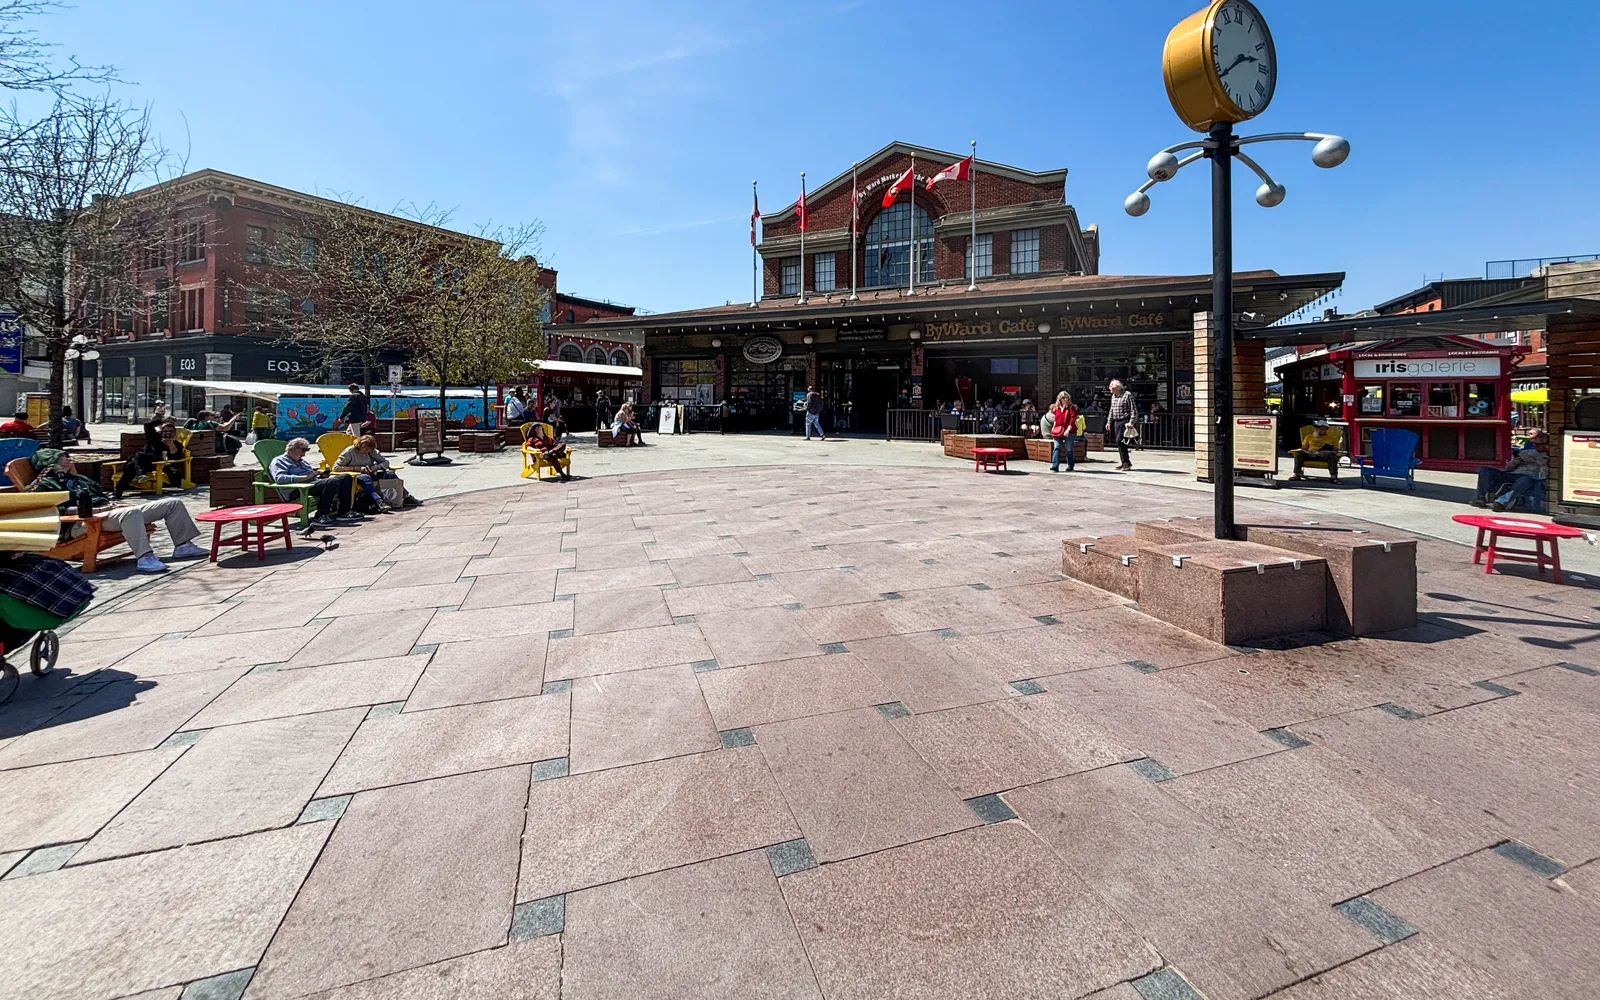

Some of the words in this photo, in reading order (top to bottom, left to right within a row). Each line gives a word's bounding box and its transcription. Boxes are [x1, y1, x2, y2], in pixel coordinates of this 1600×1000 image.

[866, 178, 880, 191] Ward
[925, 322, 992, 340] ByWard
[998, 317, 1036, 334] Café
[1059, 315, 1121, 332] ByWard
[1128, 312, 1163, 327] Café
[180, 359, 196, 370] EQ3
[268, 360, 299, 372] EQ3
